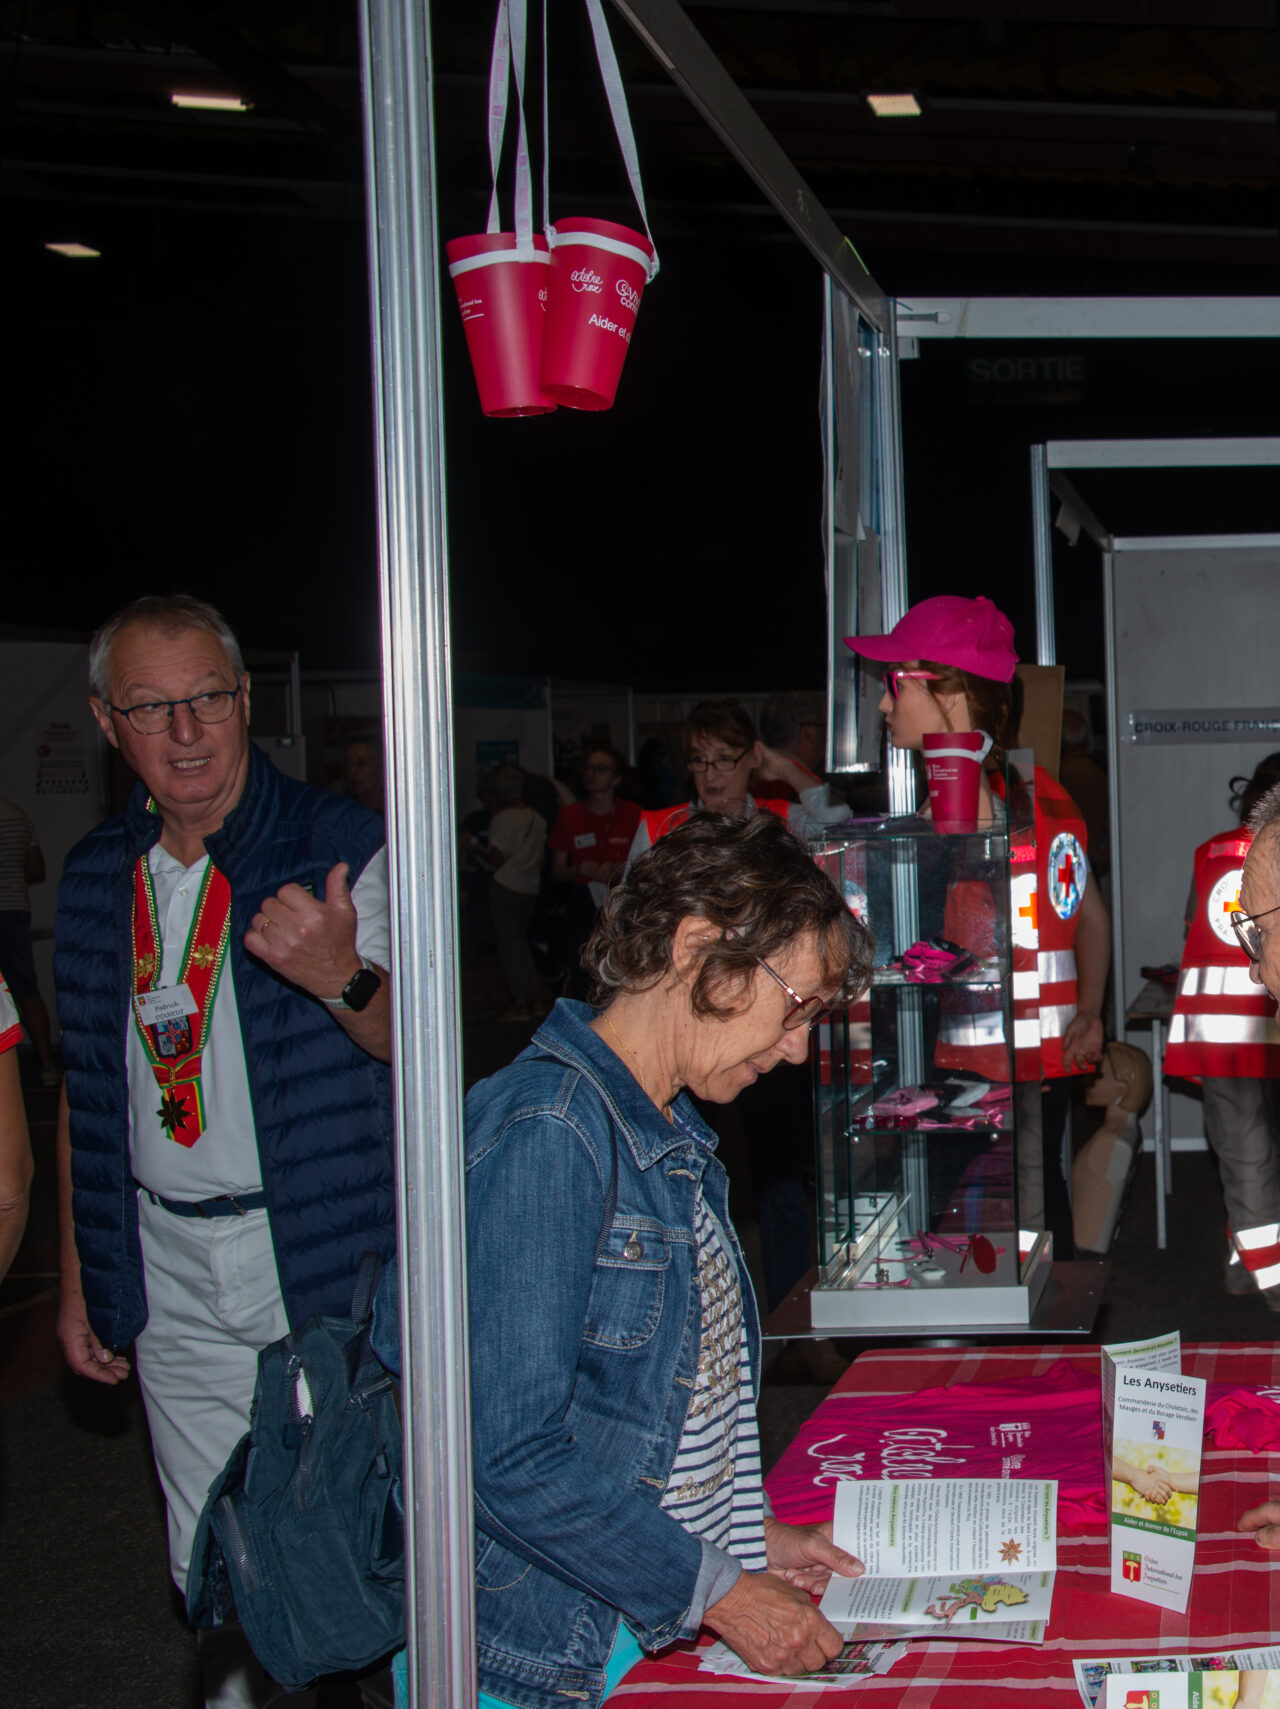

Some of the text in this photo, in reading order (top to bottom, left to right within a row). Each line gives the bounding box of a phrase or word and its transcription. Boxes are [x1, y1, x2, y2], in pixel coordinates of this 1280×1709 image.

[588, 313, 618, 333] Aider
[968, 355, 1087, 382] SORTIE
[1134, 719, 1230, 734] CROIX-ROUGE
[1123, 1375, 1197, 1396] Les Anysetiers
[1118, 1396, 1156, 1407] Commanderie
[1157, 1401, 1165, 1409] du
[1189, 1407, 1199, 1415] des
[1119, 1404, 1141, 1414] Mauges
[1141, 1406, 1148, 1414] et
[1148, 1407, 1156, 1415] du
[1156, 1409, 1175, 1419] Bocage
[1124, 1516, 1137, 1525] Aider
[1138, 1519, 1144, 1527] et
[1144, 1520, 1162, 1531] donner
[1162, 1525, 1170, 1533] de
[1143, 1563, 1175, 1579] International
[1192, 1690, 1200, 1709] Aide
